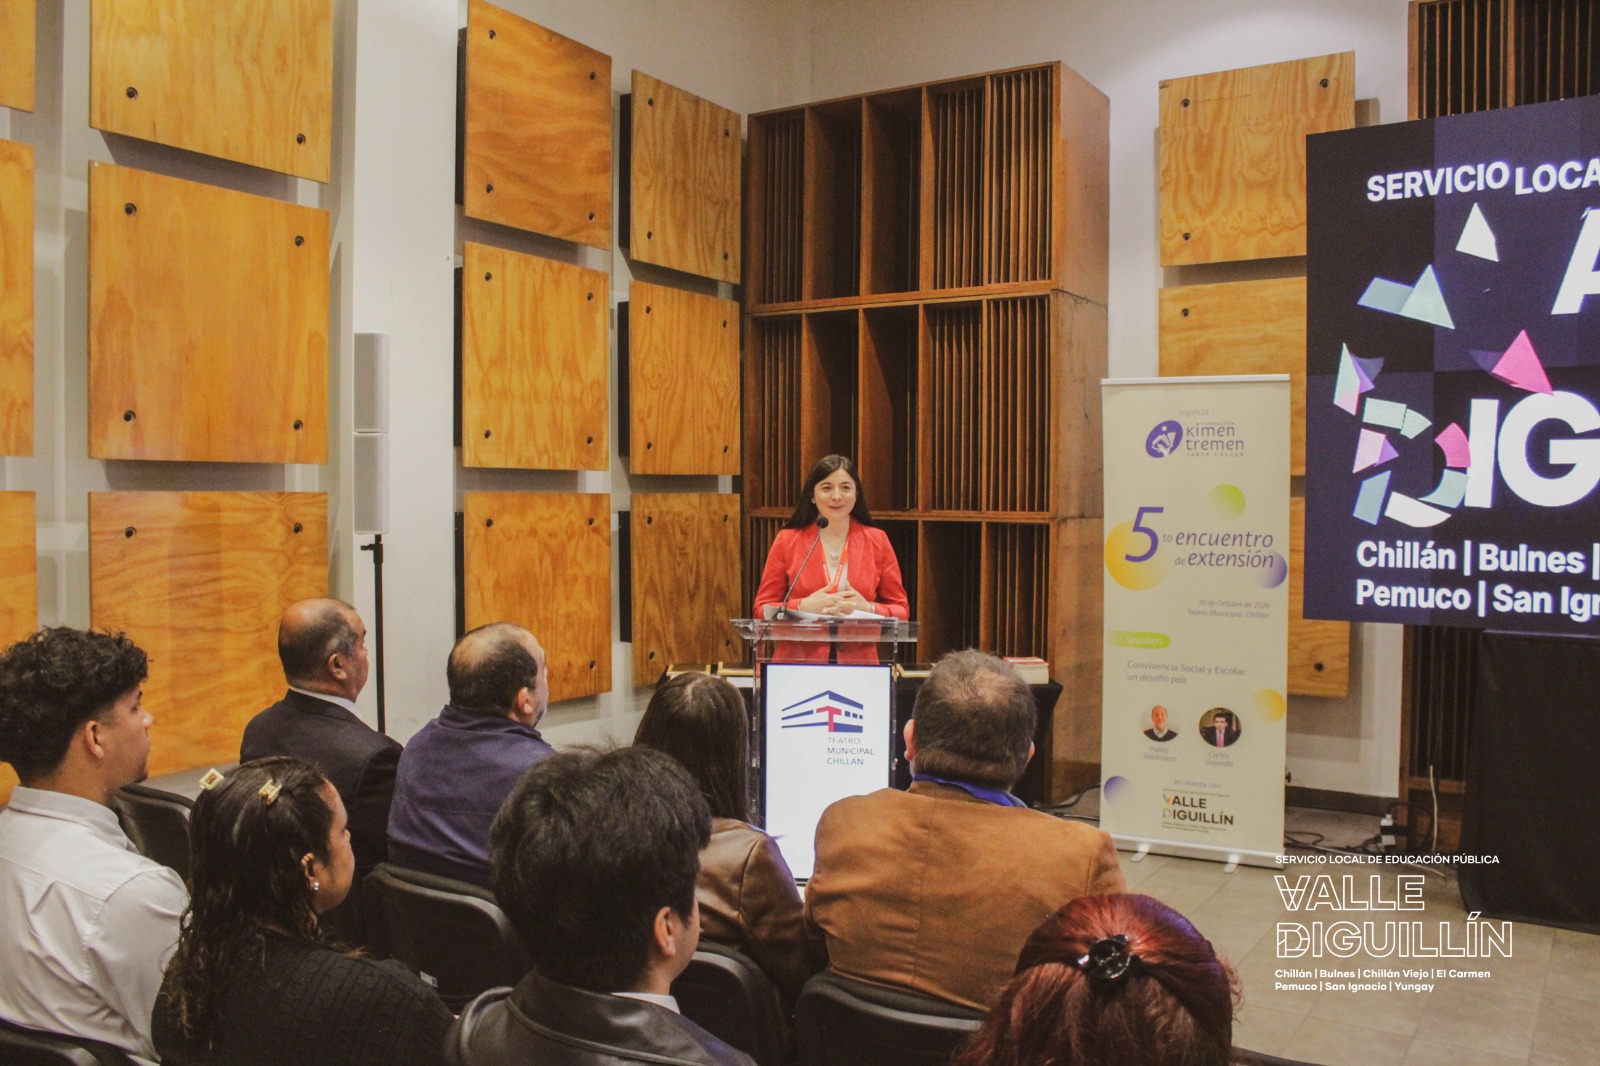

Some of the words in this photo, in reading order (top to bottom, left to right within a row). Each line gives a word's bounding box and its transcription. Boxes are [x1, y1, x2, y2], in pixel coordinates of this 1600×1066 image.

[1366, 161, 1510, 202] SERVICIO
[1186, 439, 1244, 451] tremen
[1175, 531, 1274, 548] encuentro
[1174, 556, 1186, 566] de
[1188, 550, 1274, 568] extensión
[1356, 540, 1456, 570] Chillán
[1478, 543, 1586, 574] Bulnes
[1356, 579, 1471, 610] Pemuco
[1492, 584, 1554, 613] San
[1127, 660, 1179, 671] Convivencia
[1180, 664, 1206, 673] Social
[1207, 668, 1212, 676] y
[827, 737, 861, 745] TEATRO
[827, 747, 875, 756] MUNICIPAL
[1162, 794, 1207, 809] VALLE
[1162, 808, 1234, 826] DIGUILLÍN
